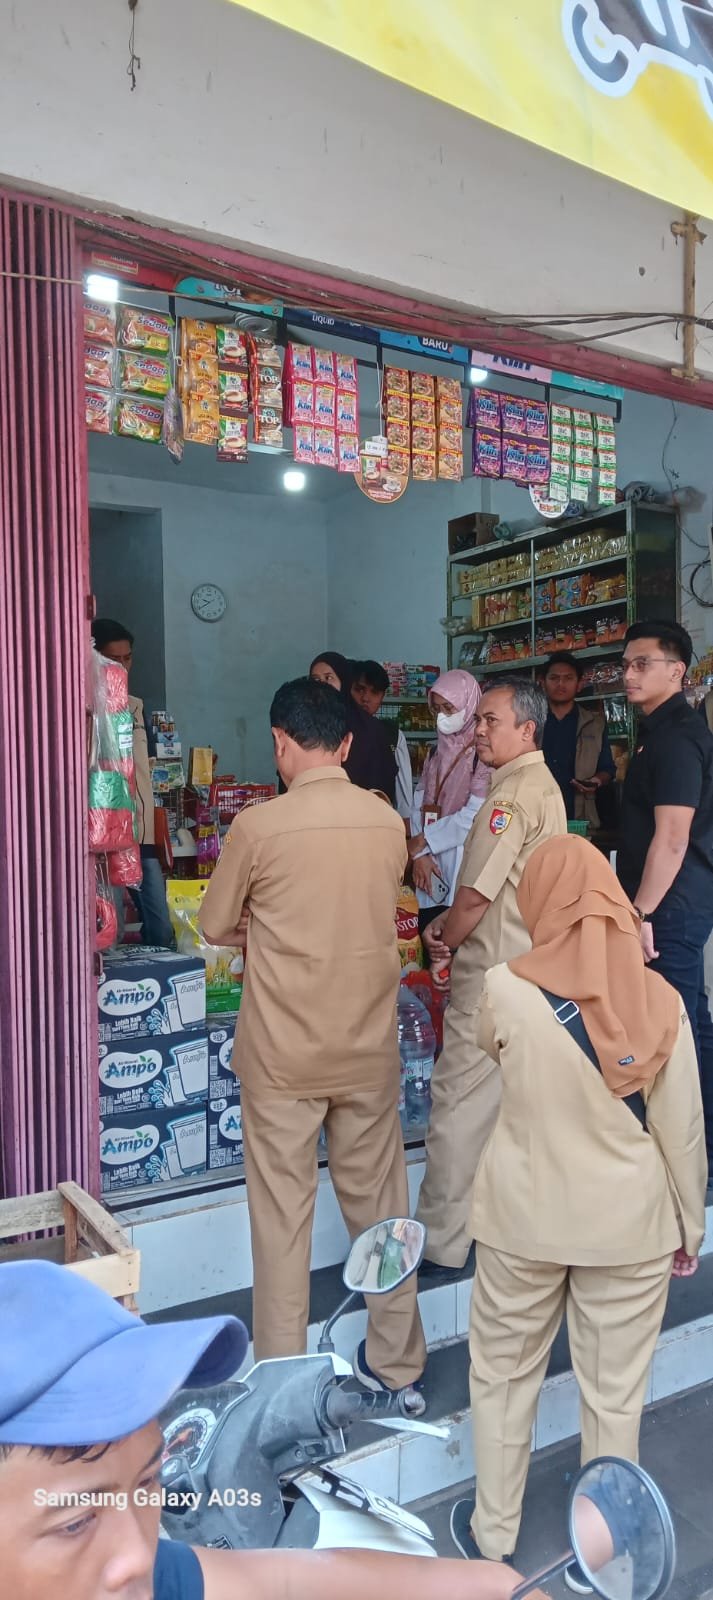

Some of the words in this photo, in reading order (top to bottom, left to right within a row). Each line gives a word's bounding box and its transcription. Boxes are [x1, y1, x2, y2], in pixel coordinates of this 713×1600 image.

[312, 313, 335, 326] LIQUID
[259, 374, 280, 384] TOP
[258, 414, 280, 425] TOP
[103, 989, 155, 1006] Ampo
[105, 1061, 156, 1078] Ampo
[102, 1137, 153, 1155] Ampo
